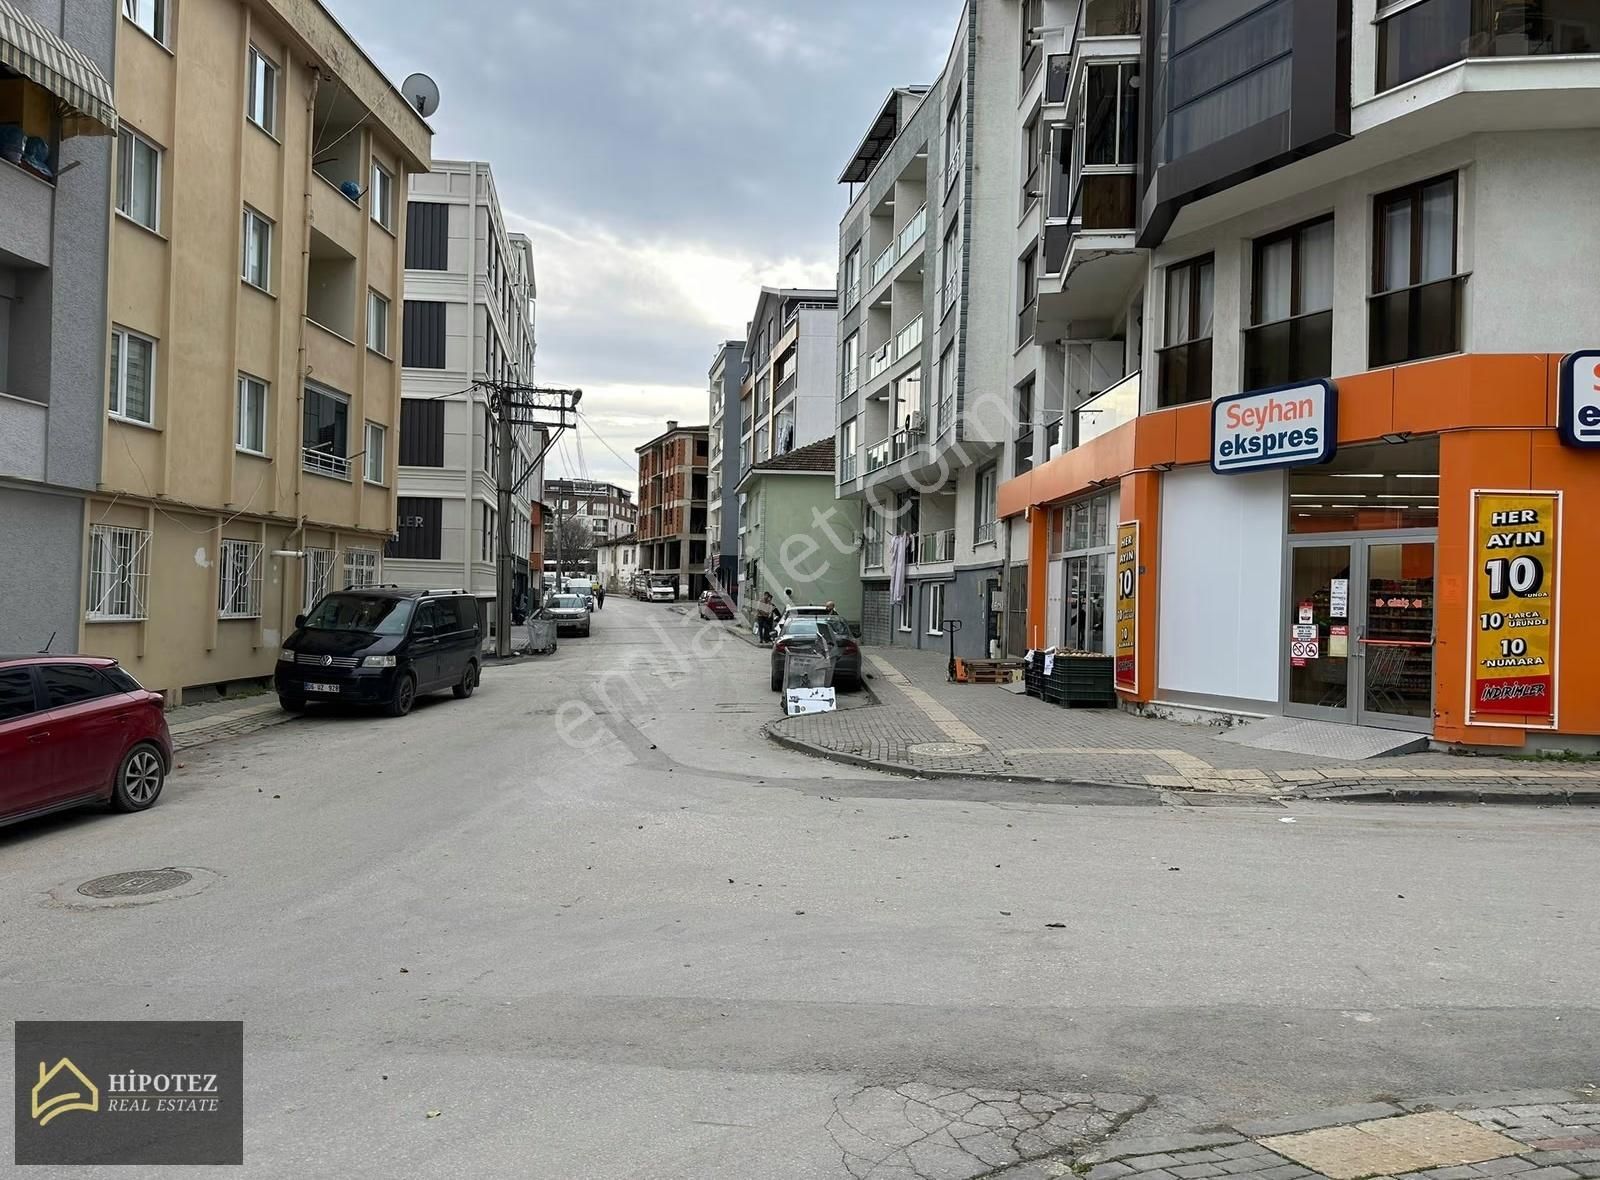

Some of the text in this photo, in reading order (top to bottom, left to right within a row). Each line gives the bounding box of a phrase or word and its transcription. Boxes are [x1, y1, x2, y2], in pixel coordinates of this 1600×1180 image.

[1226, 398, 1313, 432] Seyhan
[1219, 427, 1318, 457] ekspres
[1491, 509, 1537, 526] HER
[1486, 531, 1543, 548] AYIN
[1118, 568, 1134, 598] 10
[1486, 555, 1541, 598] 10
[1480, 612, 1503, 630] 10
[1501, 638, 1526, 657] 10
